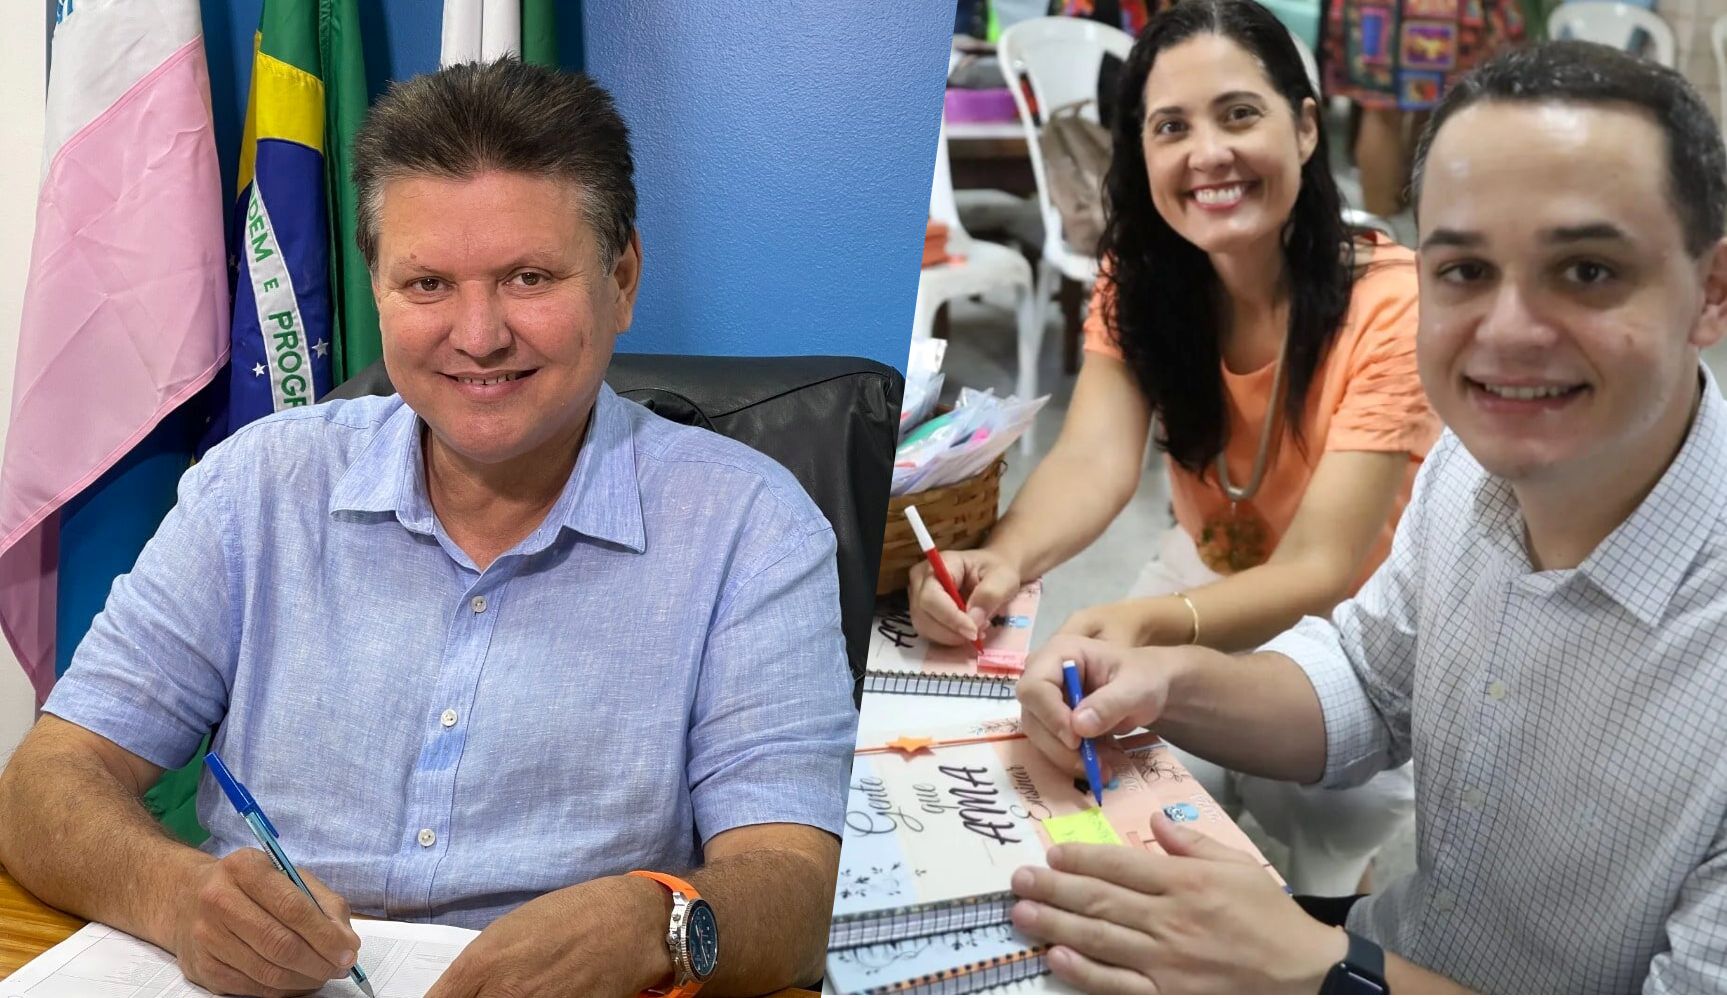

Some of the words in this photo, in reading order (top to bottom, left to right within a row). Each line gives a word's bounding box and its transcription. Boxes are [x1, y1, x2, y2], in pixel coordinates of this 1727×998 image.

[263, 277, 280, 294] E
[845, 776, 924, 838] Gente
[912, 782, 960, 815] que
[938, 764, 1023, 846] AMA
